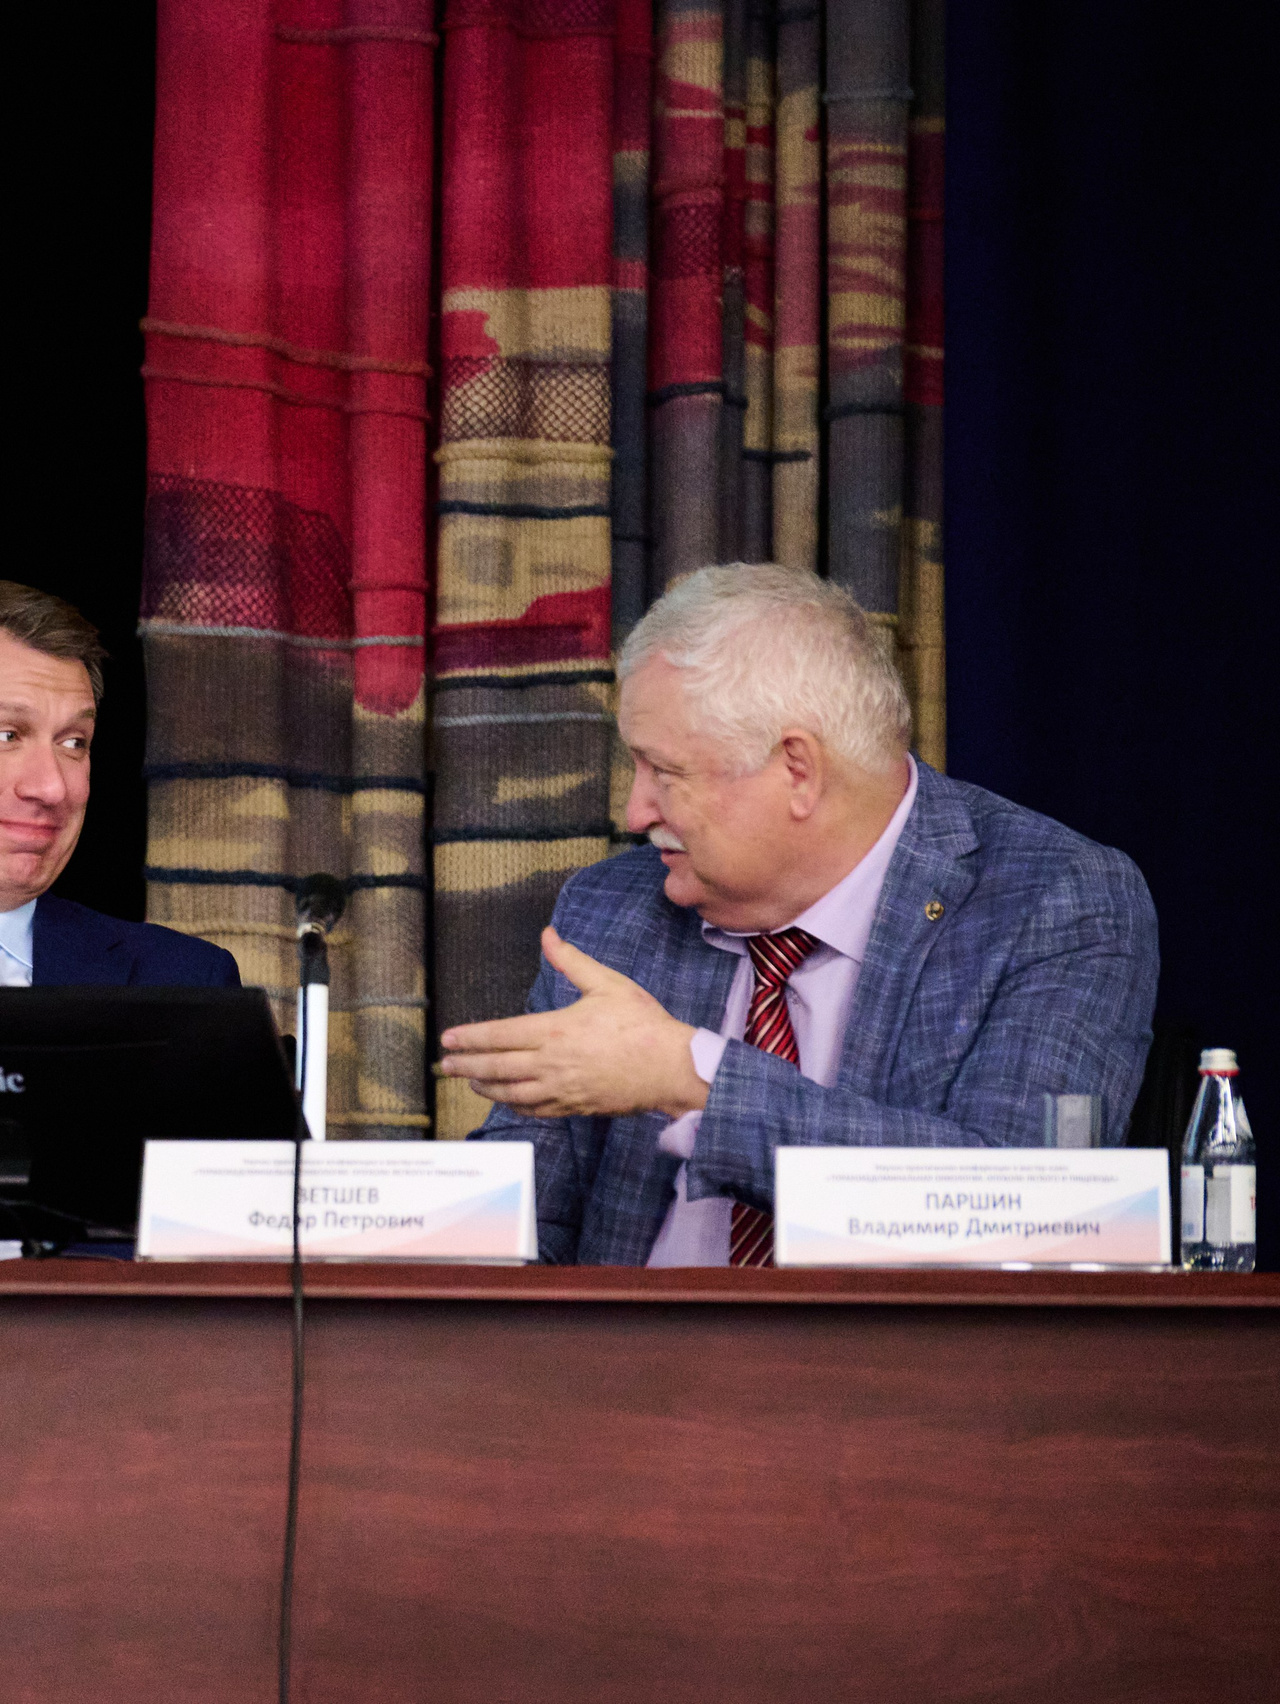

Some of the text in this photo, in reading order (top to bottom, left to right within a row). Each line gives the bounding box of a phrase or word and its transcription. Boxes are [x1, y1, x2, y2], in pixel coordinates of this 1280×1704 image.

[925, 1192, 1022, 1211] ПАРШИН
[325, 1210, 424, 1232] Петрович
[847, 1217, 1101, 1238] Владимир Дмитриевич
